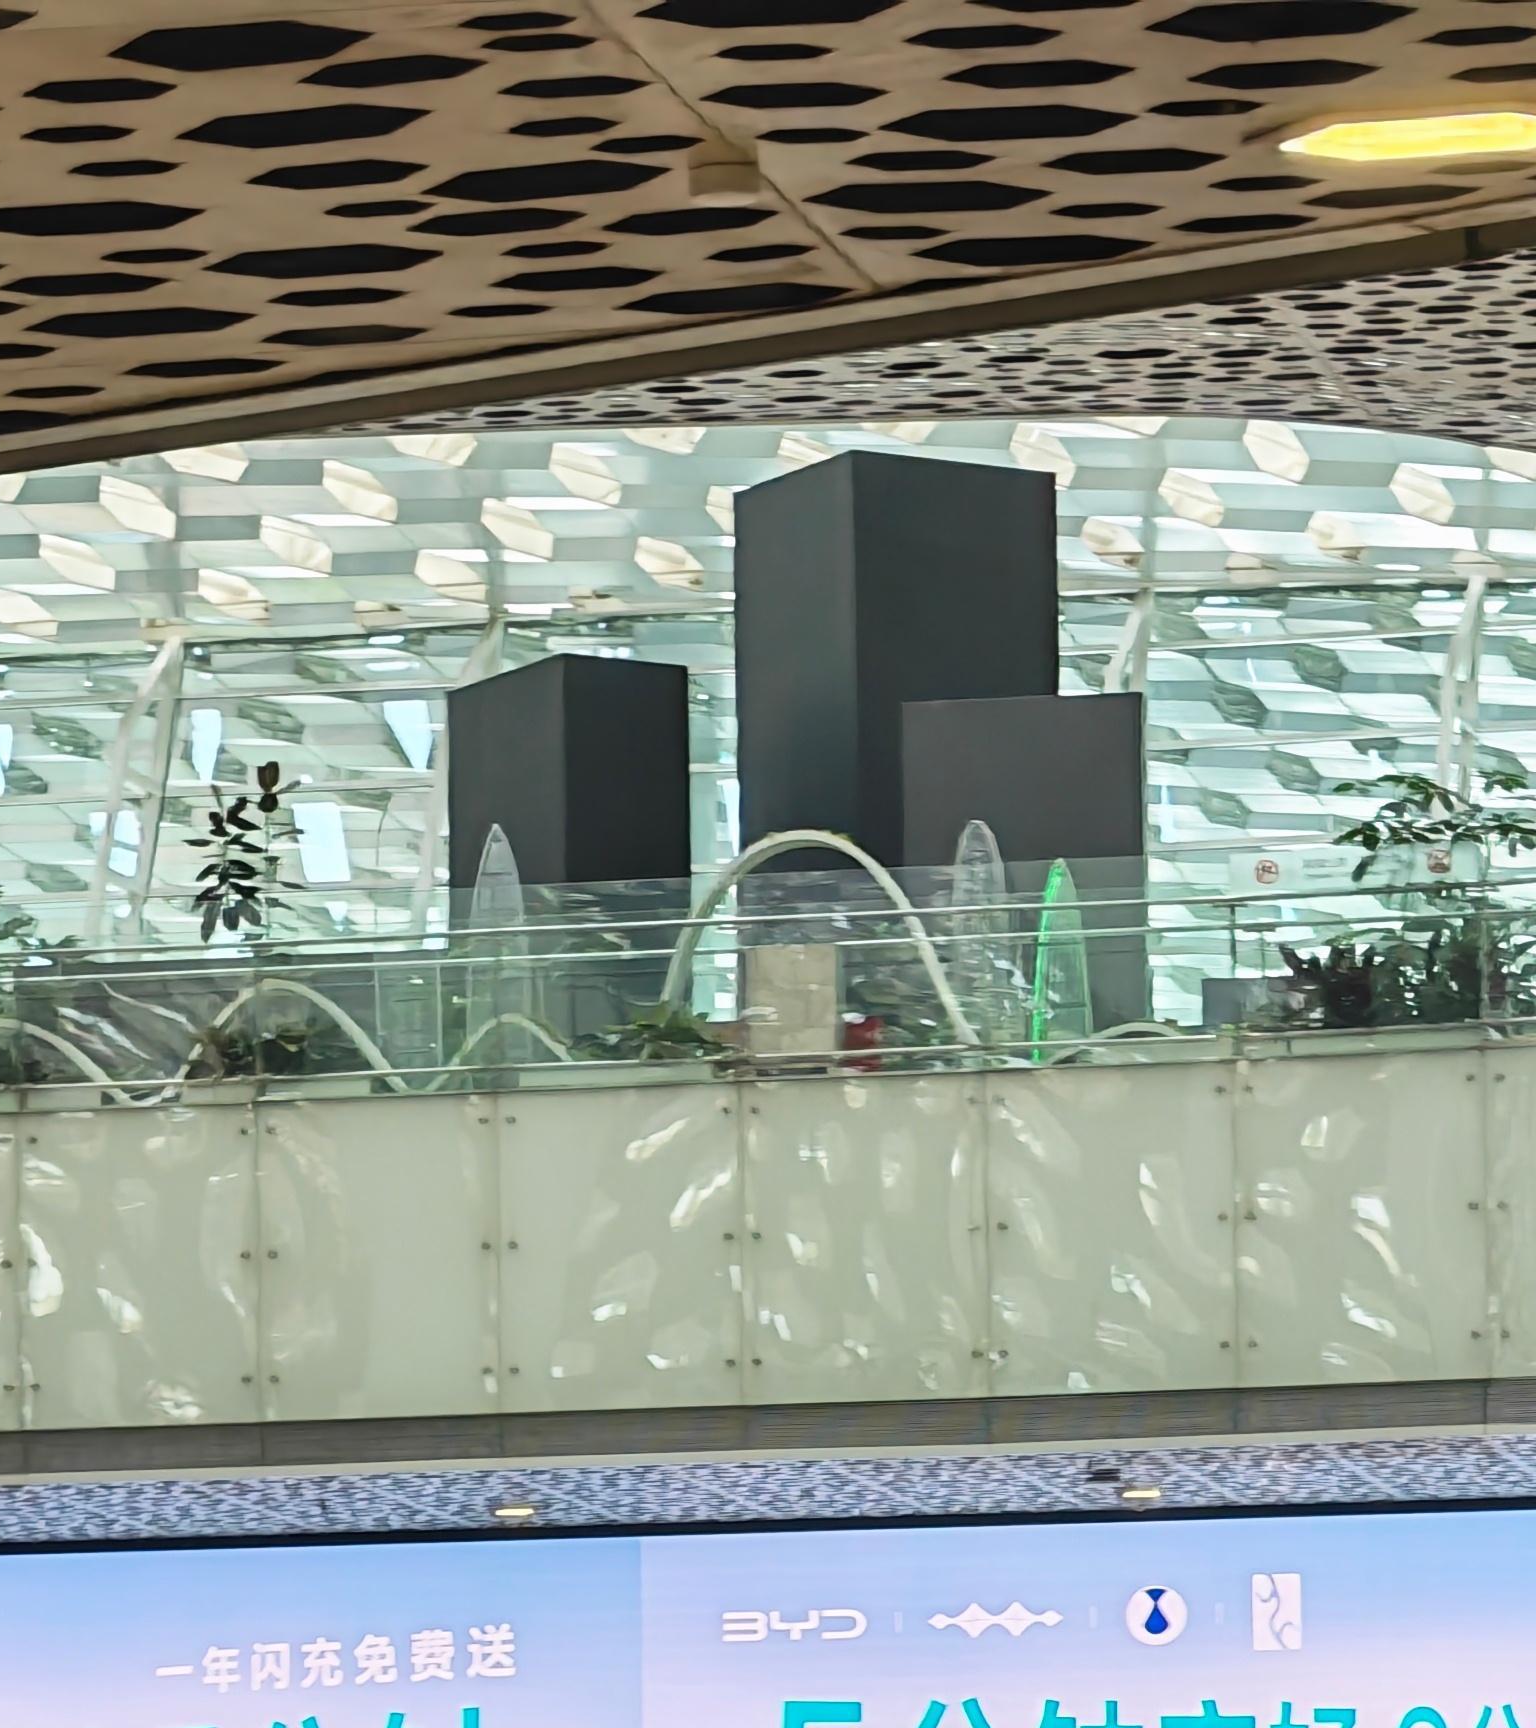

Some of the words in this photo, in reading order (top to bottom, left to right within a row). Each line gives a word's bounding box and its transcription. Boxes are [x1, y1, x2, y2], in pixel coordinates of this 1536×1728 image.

[721, 1608, 867, 1642] BYD
[156, 1624, 517, 1694] 一年闪充免费送
